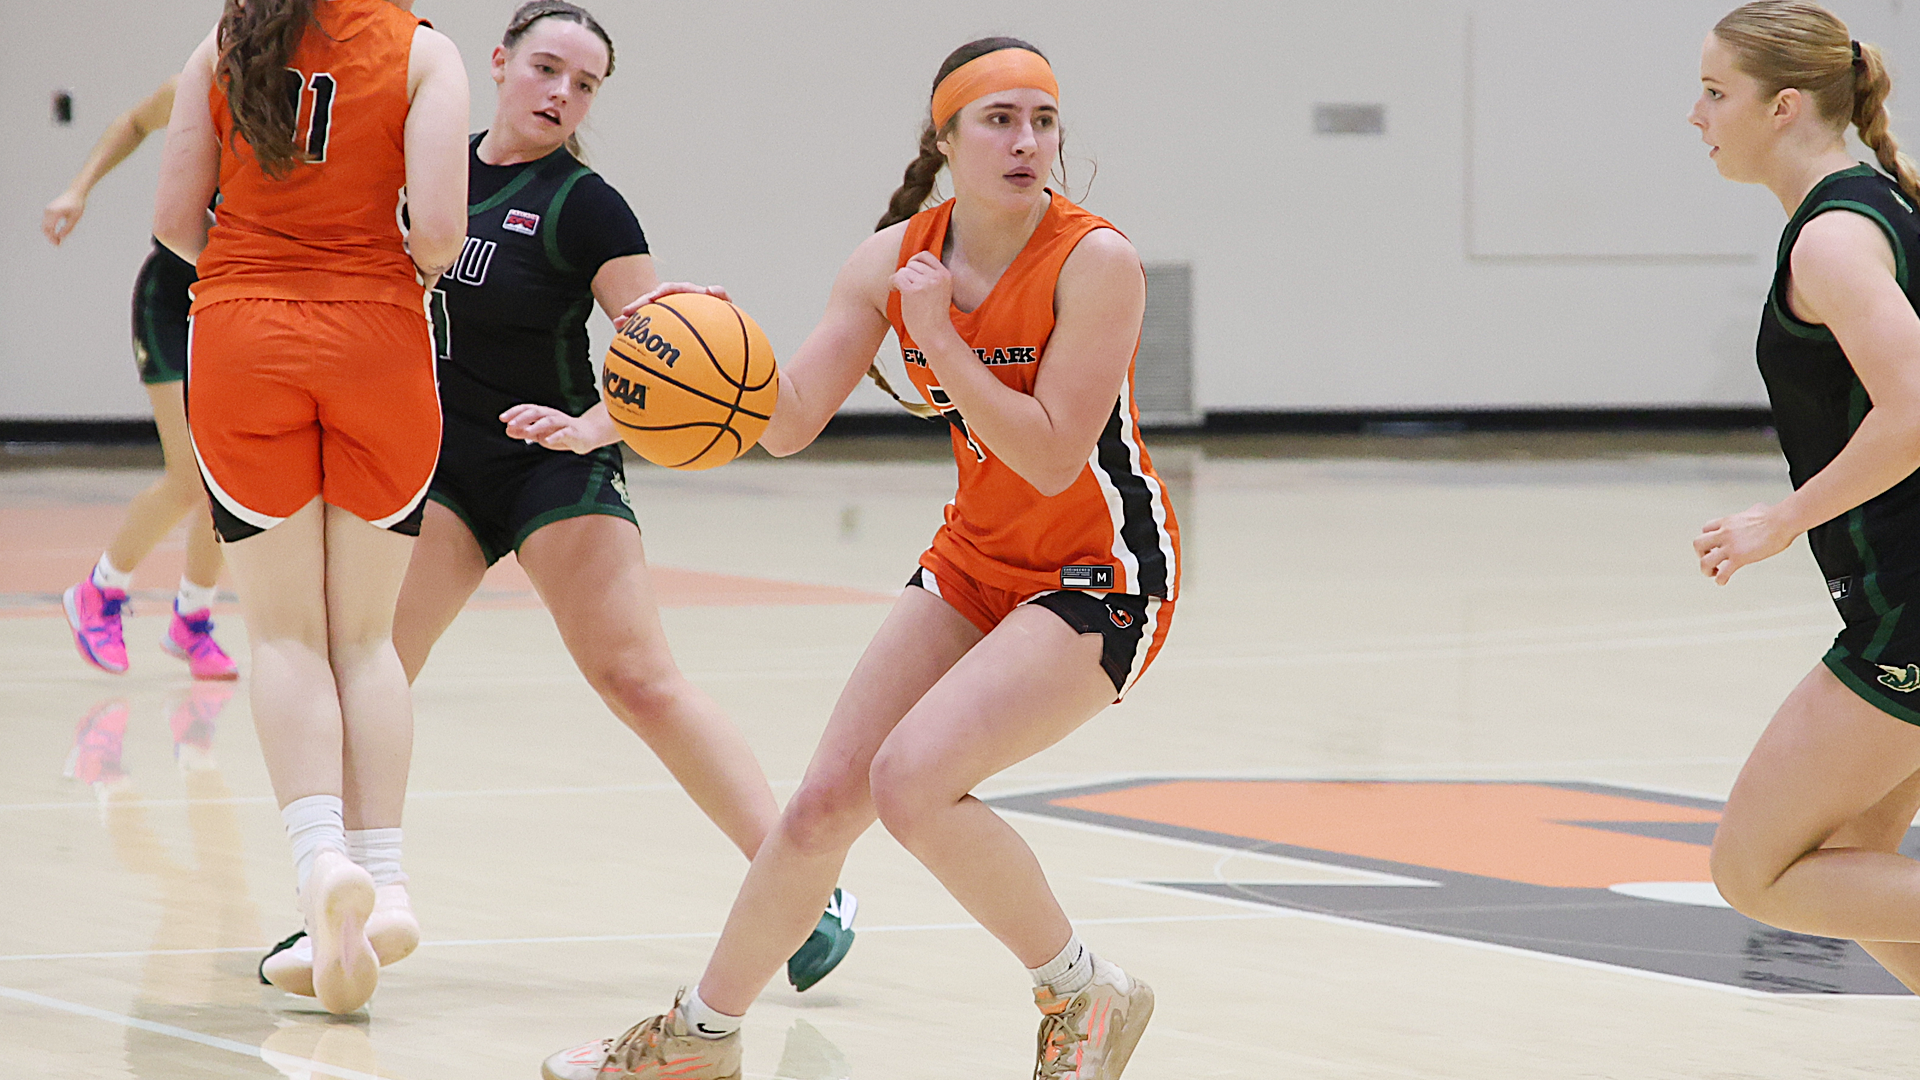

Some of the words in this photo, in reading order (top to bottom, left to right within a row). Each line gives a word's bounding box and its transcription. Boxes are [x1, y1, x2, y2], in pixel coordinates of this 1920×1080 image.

[443, 236, 497, 286] U
[971, 346, 1037, 367] LARK
[1097, 572, 1107, 583] M
[1841, 582, 1847, 593] L
